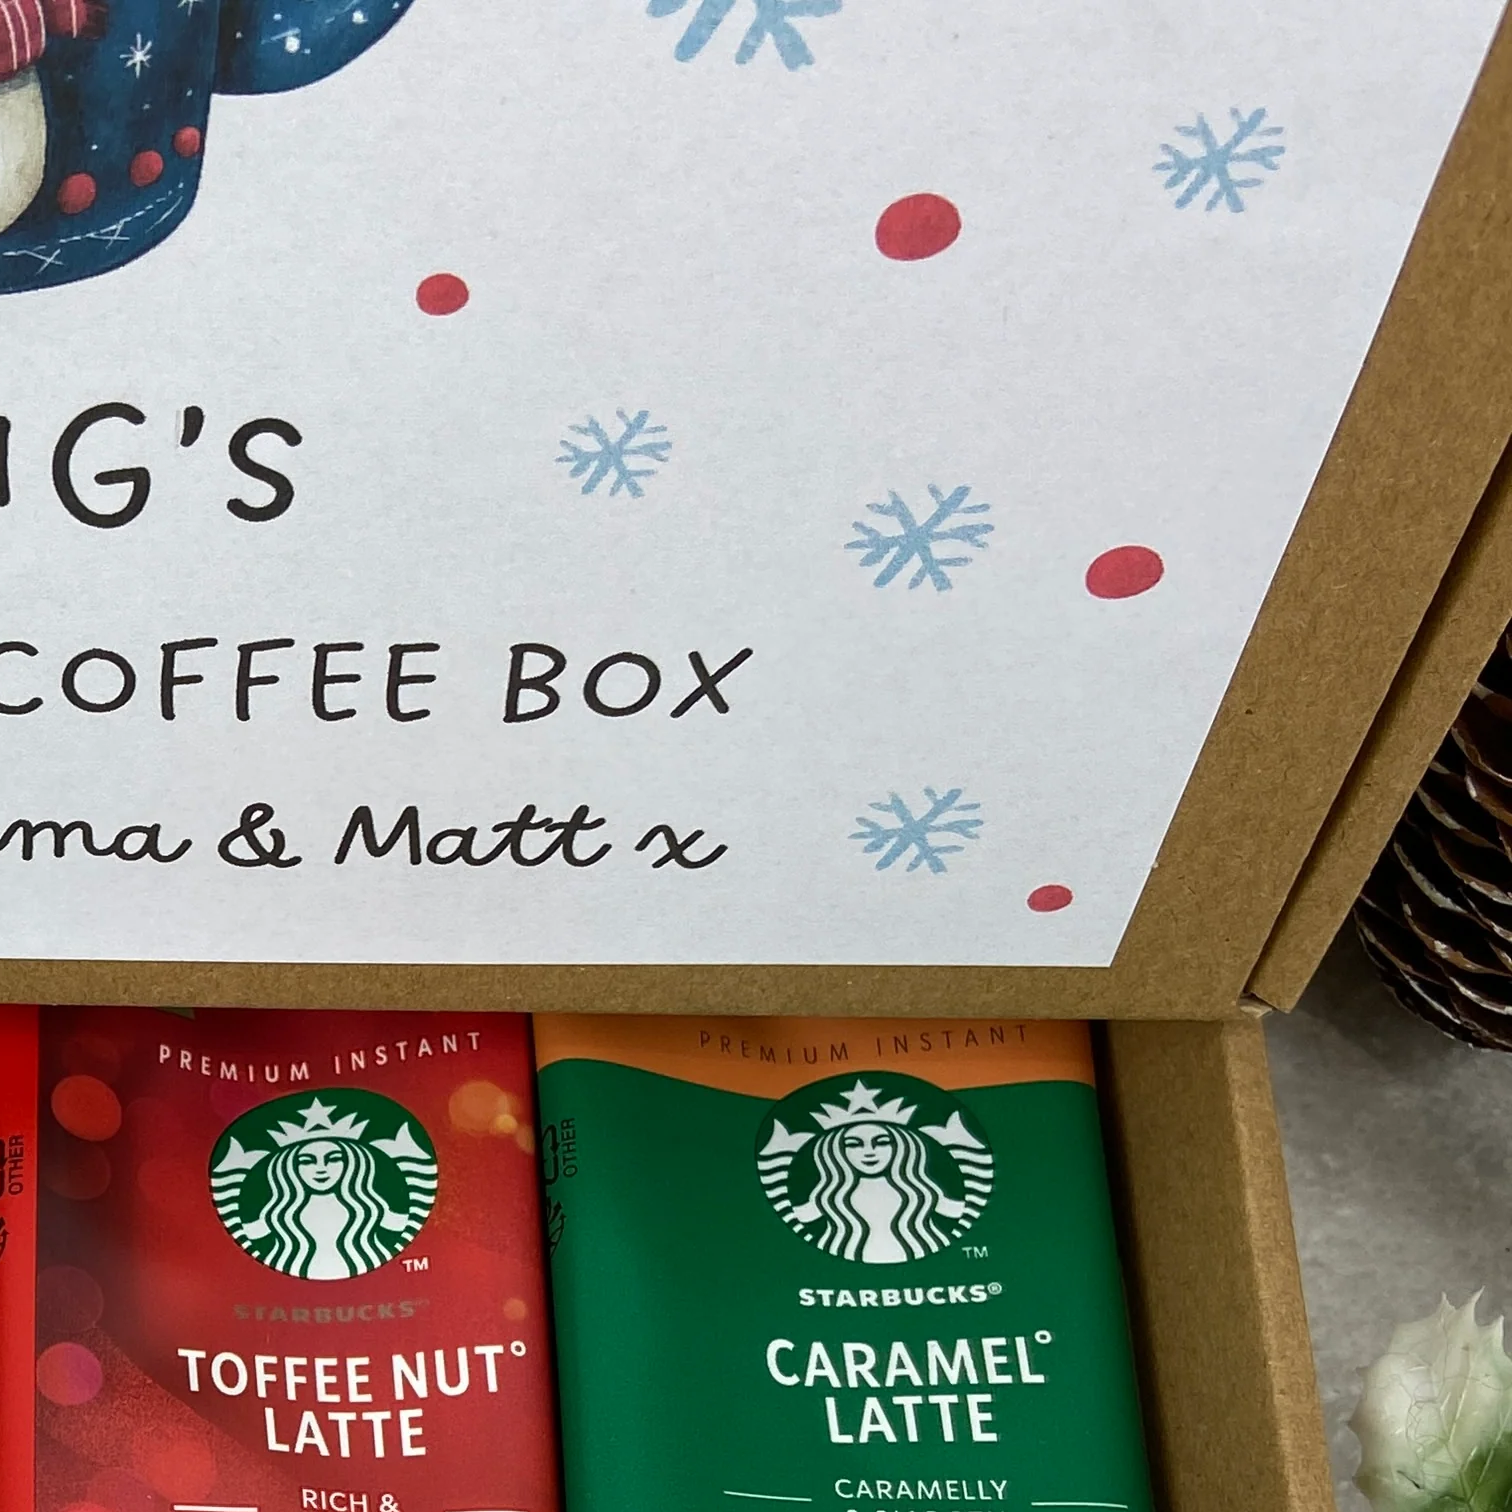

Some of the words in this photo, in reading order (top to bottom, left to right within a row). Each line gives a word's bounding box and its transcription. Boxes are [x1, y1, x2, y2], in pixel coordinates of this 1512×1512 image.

[503, 642, 754, 724] BOX
[217, 802, 301, 868] &
[335, 803, 611, 868] Matt
[634, 826, 728, 869] x
[159, 1044, 310, 1084] PREMIUM
[334, 1032, 483, 1076] INSTANT
[699, 1030, 850, 1064] PREMIUM
[875, 1024, 1030, 1058] INSTANT
[8, 1134, 25, 1195] OTHER
[563, 1116, 577, 1179] OTHER
[177, 1348, 373, 1404] TOFFEE
[264, 1406, 427, 1459] LATTE
[825, 1394, 999, 1444] LATTE
[834, 1478, 1008, 1501] CARAMELLY
